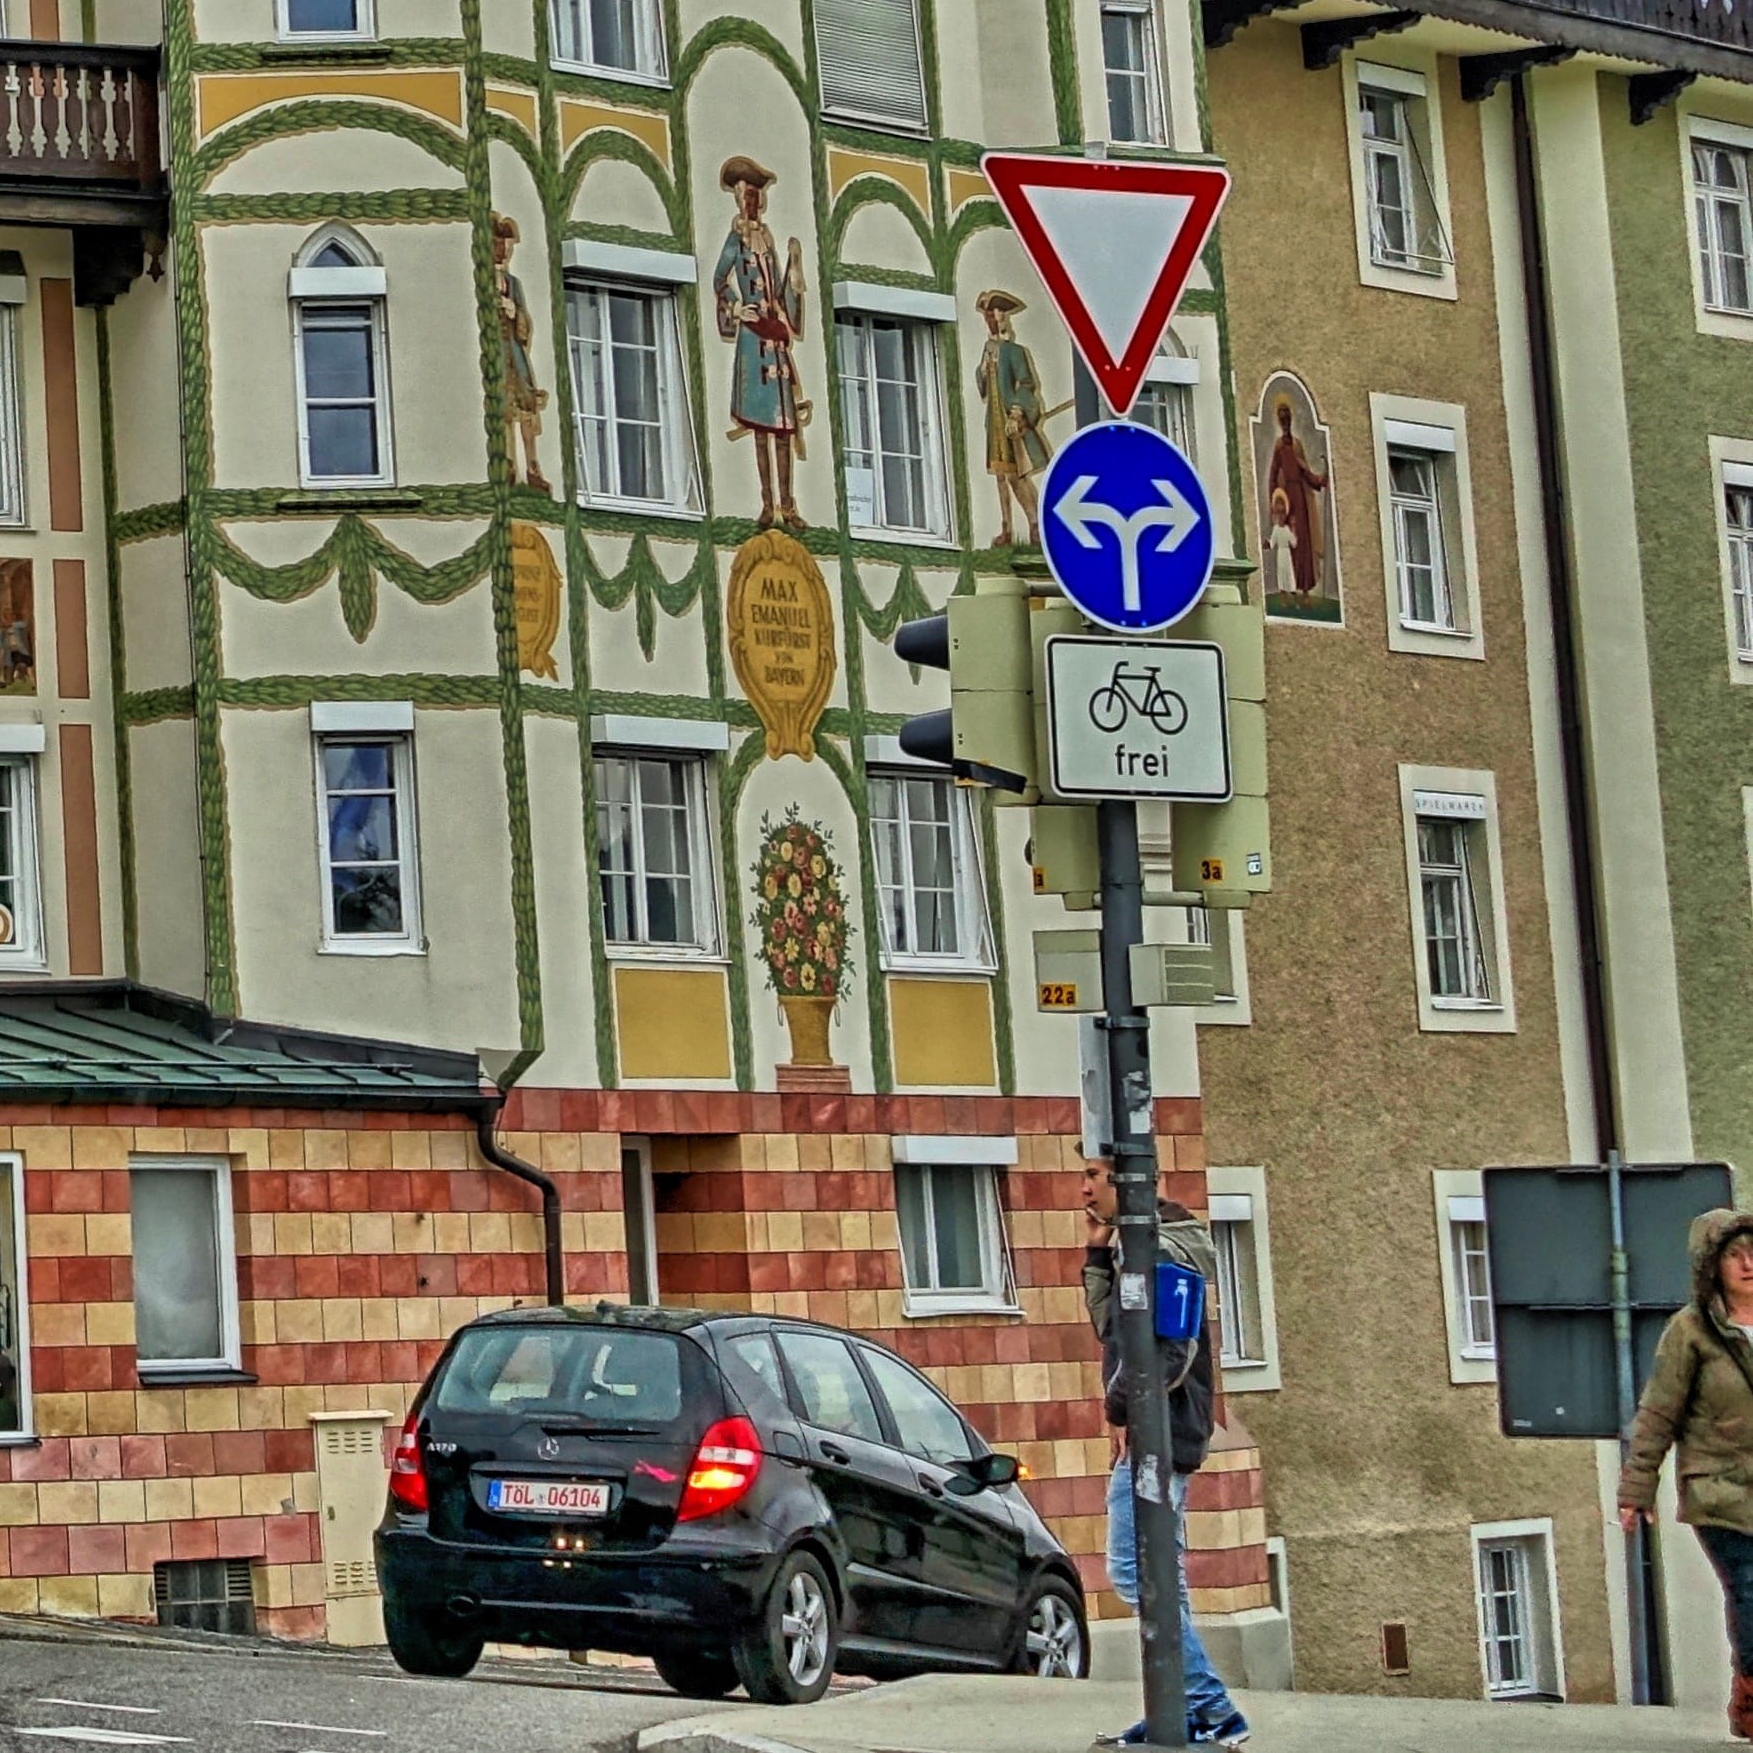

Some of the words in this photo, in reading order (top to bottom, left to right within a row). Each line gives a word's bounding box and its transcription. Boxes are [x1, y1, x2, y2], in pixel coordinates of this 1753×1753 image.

[761, 577, 799, 603] MAX
[750, 603, 812, 629] EMANUEL
[1115, 744, 1169, 778] frei
[1202, 859, 1223, 881] 3a
[1043, 986, 1077, 1005] 22a
[503, 1484, 534, 1505] TÖL
[547, 1486, 601, 1509] 06104
